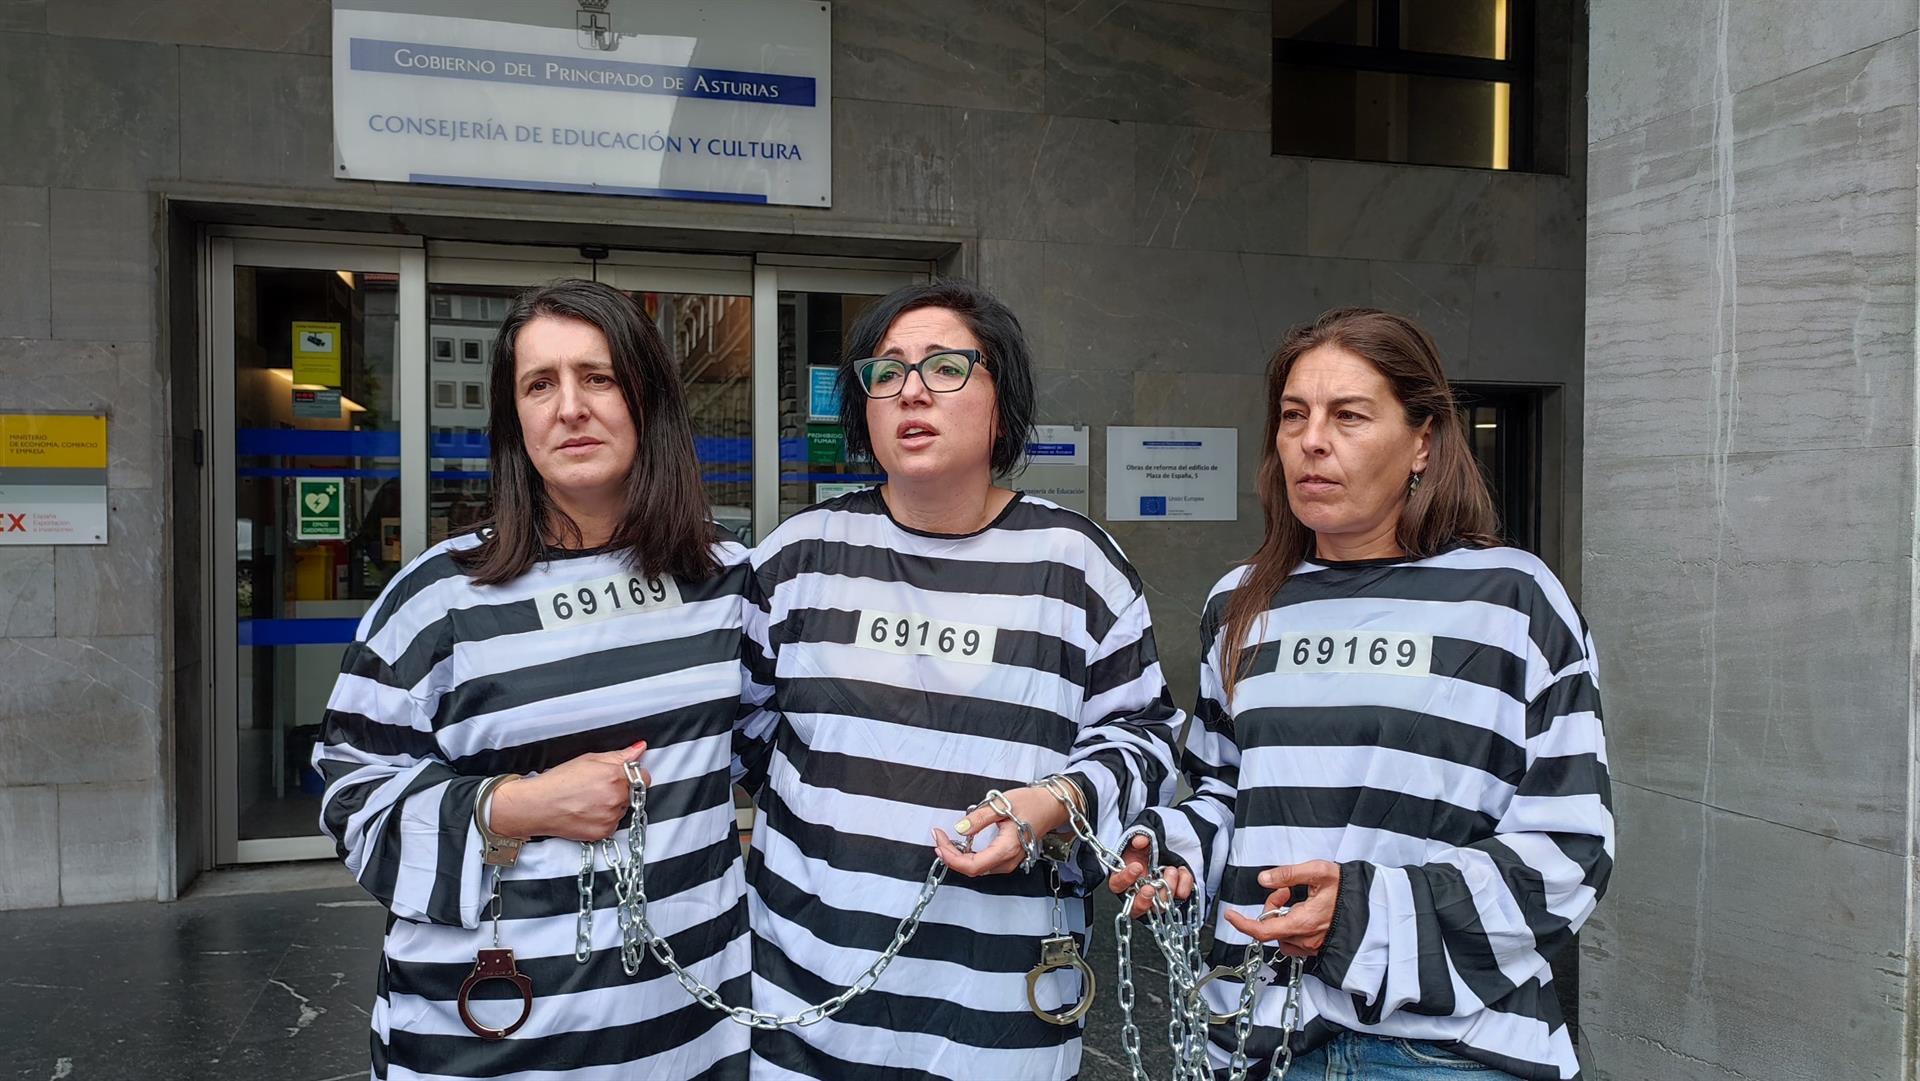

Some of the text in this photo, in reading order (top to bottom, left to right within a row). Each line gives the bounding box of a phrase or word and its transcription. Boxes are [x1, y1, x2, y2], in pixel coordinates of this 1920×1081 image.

[504, 61, 536, 79] DEL
[663, 77, 684, 91] DE
[368, 114, 803, 162] CONSEJERÍA DE EDUCACIÓN Y CULTURA
[1047, 487, 1056, 495] de
[1056, 487, 1085, 495] Educación
[1171, 472, 1194, 480] España,
[552, 577, 667, 620] 69169
[870, 617, 980, 656] 69169
[1292, 636, 1417, 668] 69169
